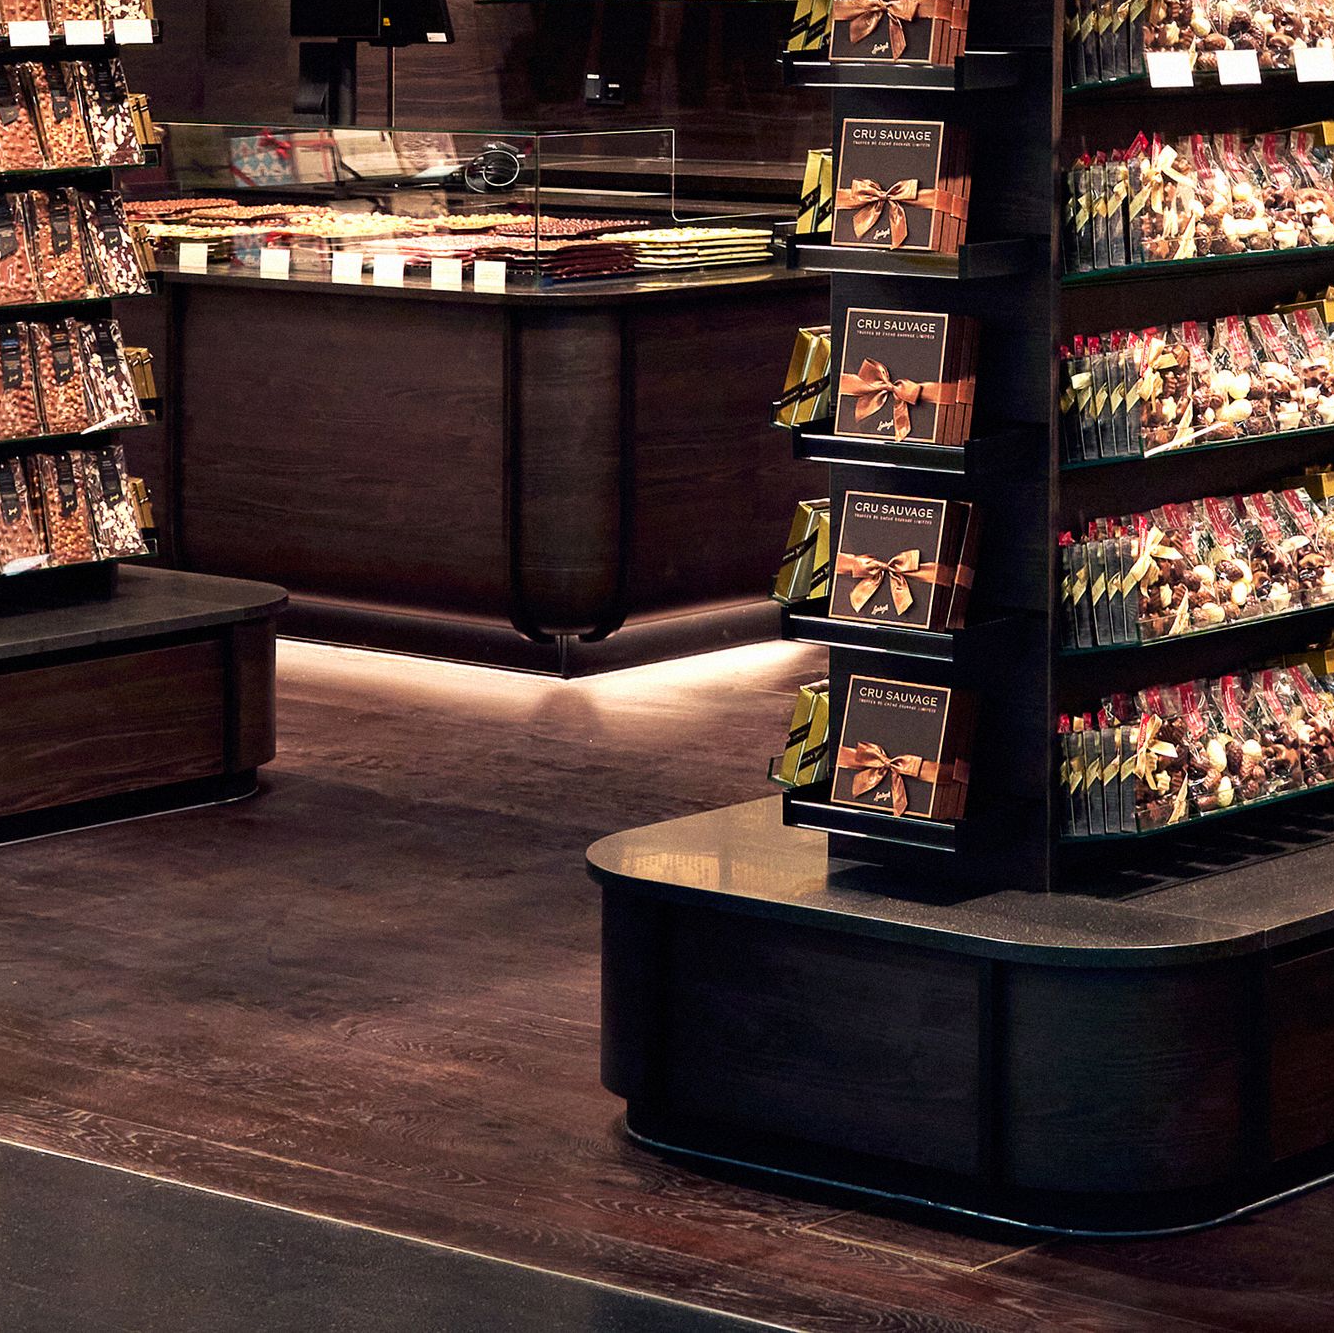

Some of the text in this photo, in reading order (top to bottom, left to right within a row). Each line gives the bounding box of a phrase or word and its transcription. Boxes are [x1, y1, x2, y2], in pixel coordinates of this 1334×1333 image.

[852, 129, 932, 141] CRU SAUVAGE
[856, 319, 936, 333] CRU SAUVAGE
[854, 501, 879, 513] CRU
[881, 504, 934, 519] SAUVAGE
[859, 686, 884, 699] CRU
[885, 690, 939, 707] SAUVAGE
